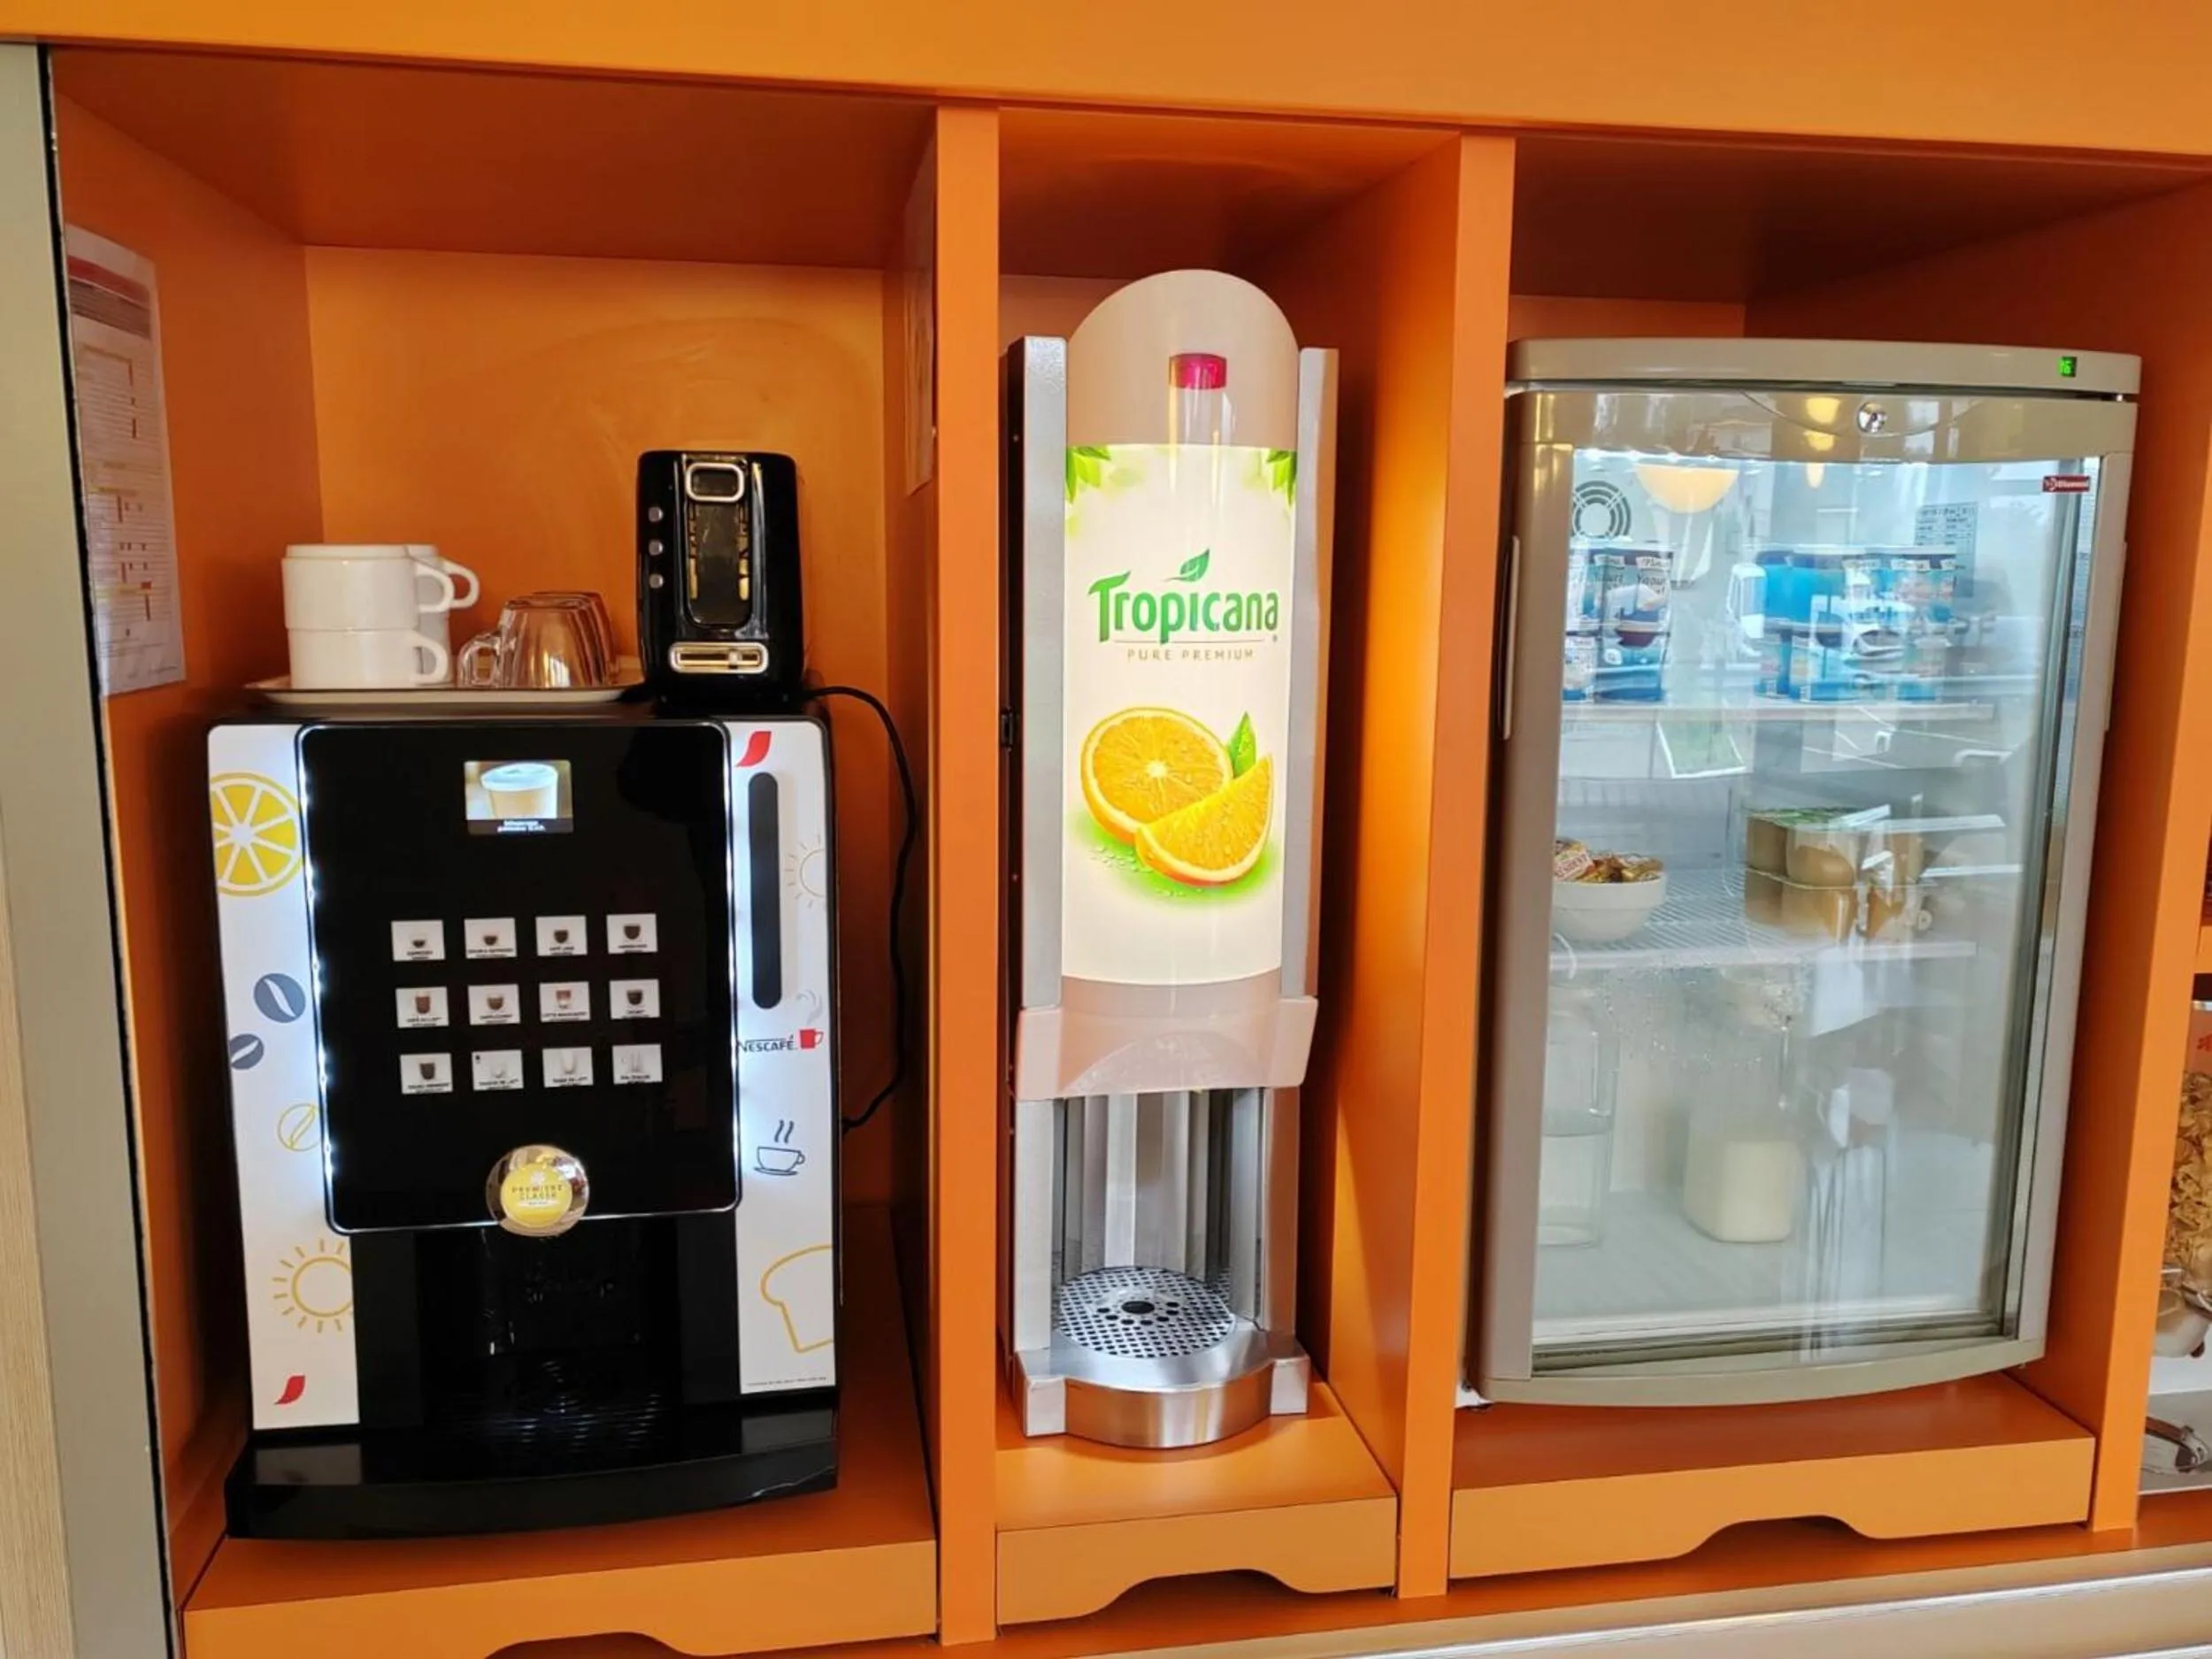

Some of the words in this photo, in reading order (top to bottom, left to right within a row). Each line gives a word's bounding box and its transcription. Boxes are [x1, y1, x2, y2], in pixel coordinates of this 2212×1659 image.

[1087, 571, 1279, 645] Tropicana
[1127, 649, 1171, 662] PURE
[1182, 648, 1254, 661] PREMIUM
